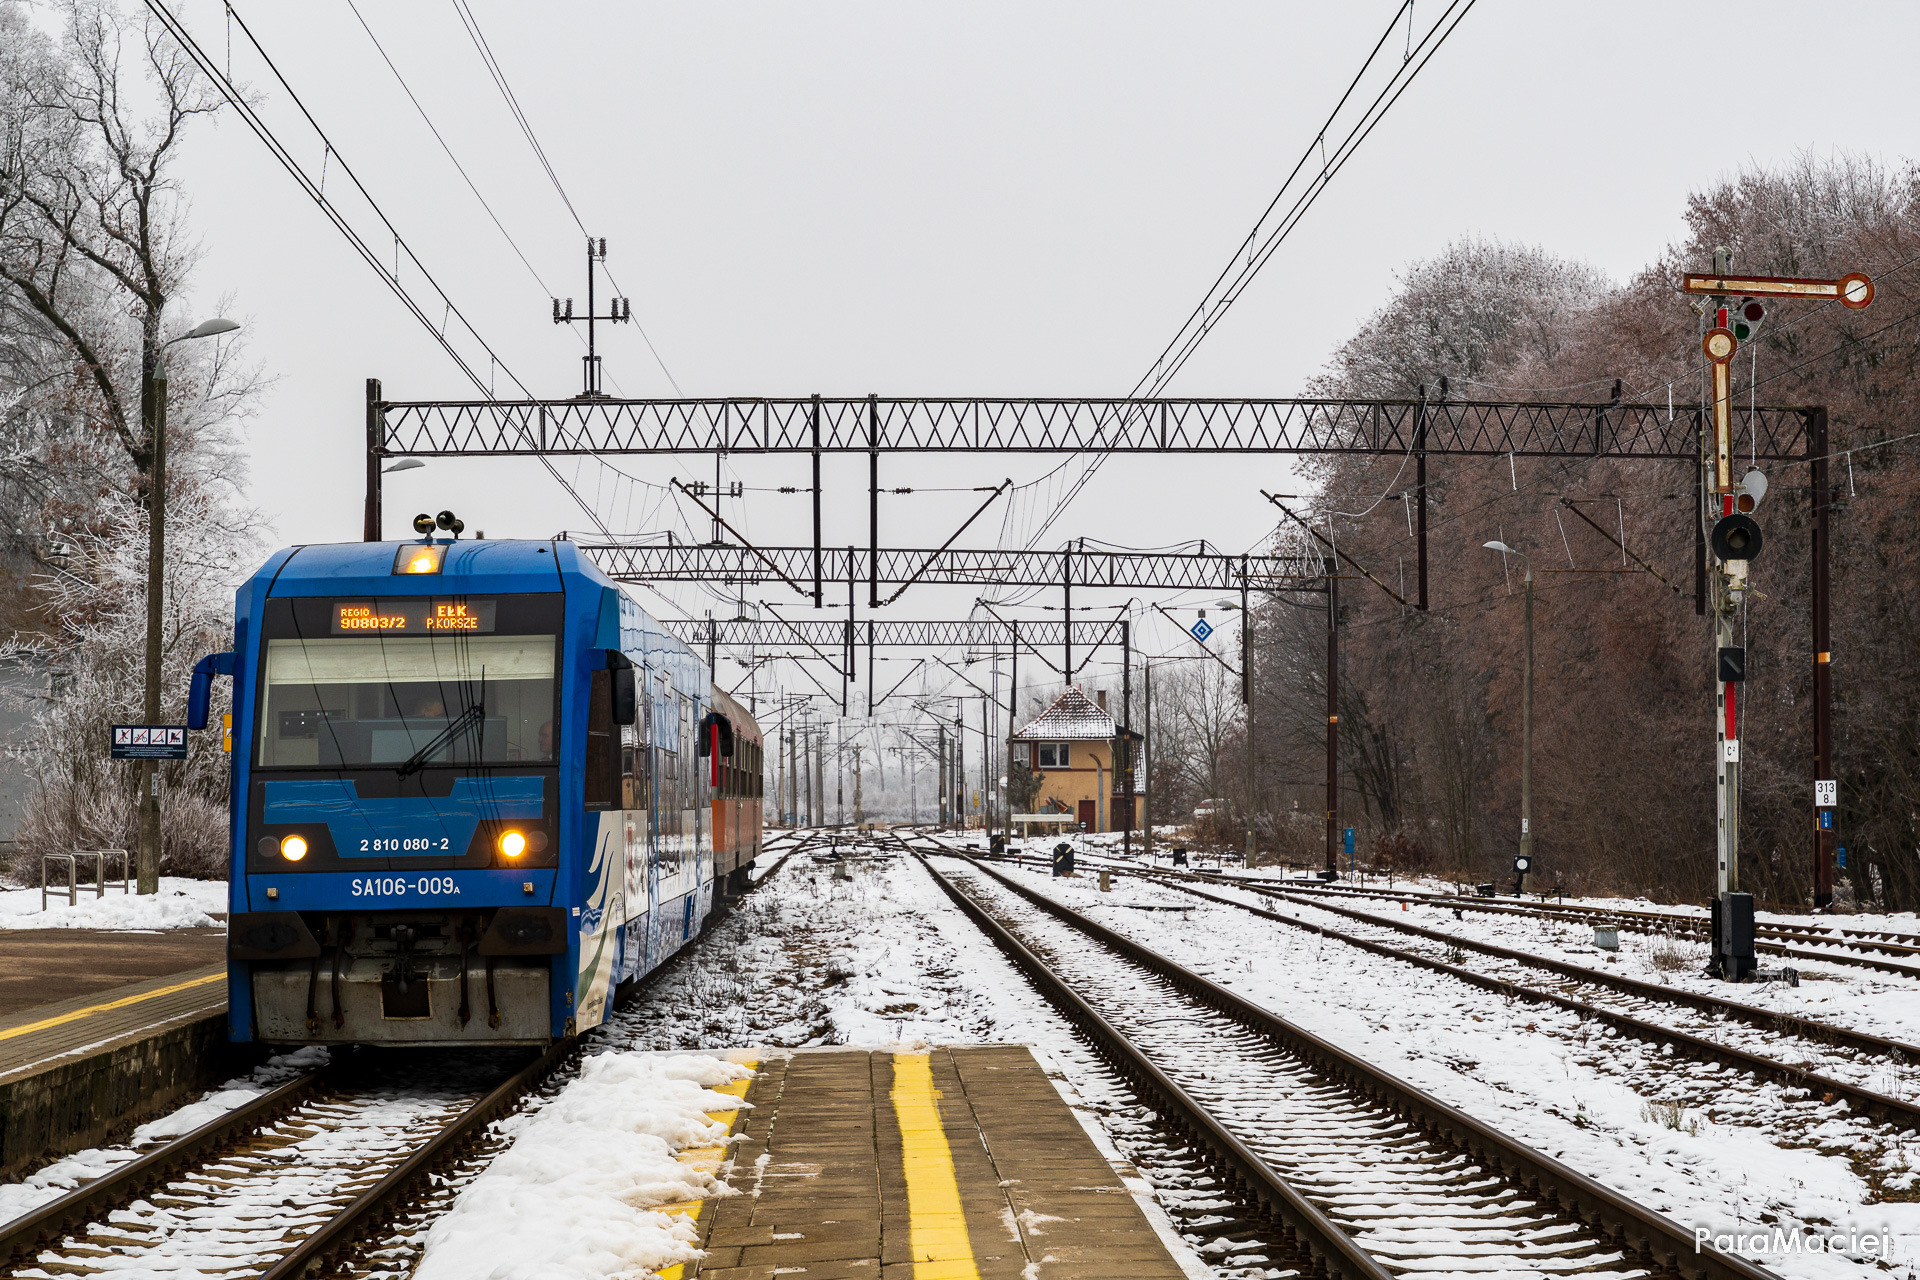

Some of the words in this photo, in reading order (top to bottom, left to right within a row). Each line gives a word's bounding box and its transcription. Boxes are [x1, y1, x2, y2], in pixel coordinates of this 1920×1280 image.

[340, 608, 370, 617] REGIO
[437, 605, 467, 617] EŁK
[340, 617, 406, 629] 90803/2
[1817, 782, 1835, 793] 313
[1823, 793, 1830, 804] 8
[360, 839, 369, 851] 2
[373, 838, 399, 851] 810
